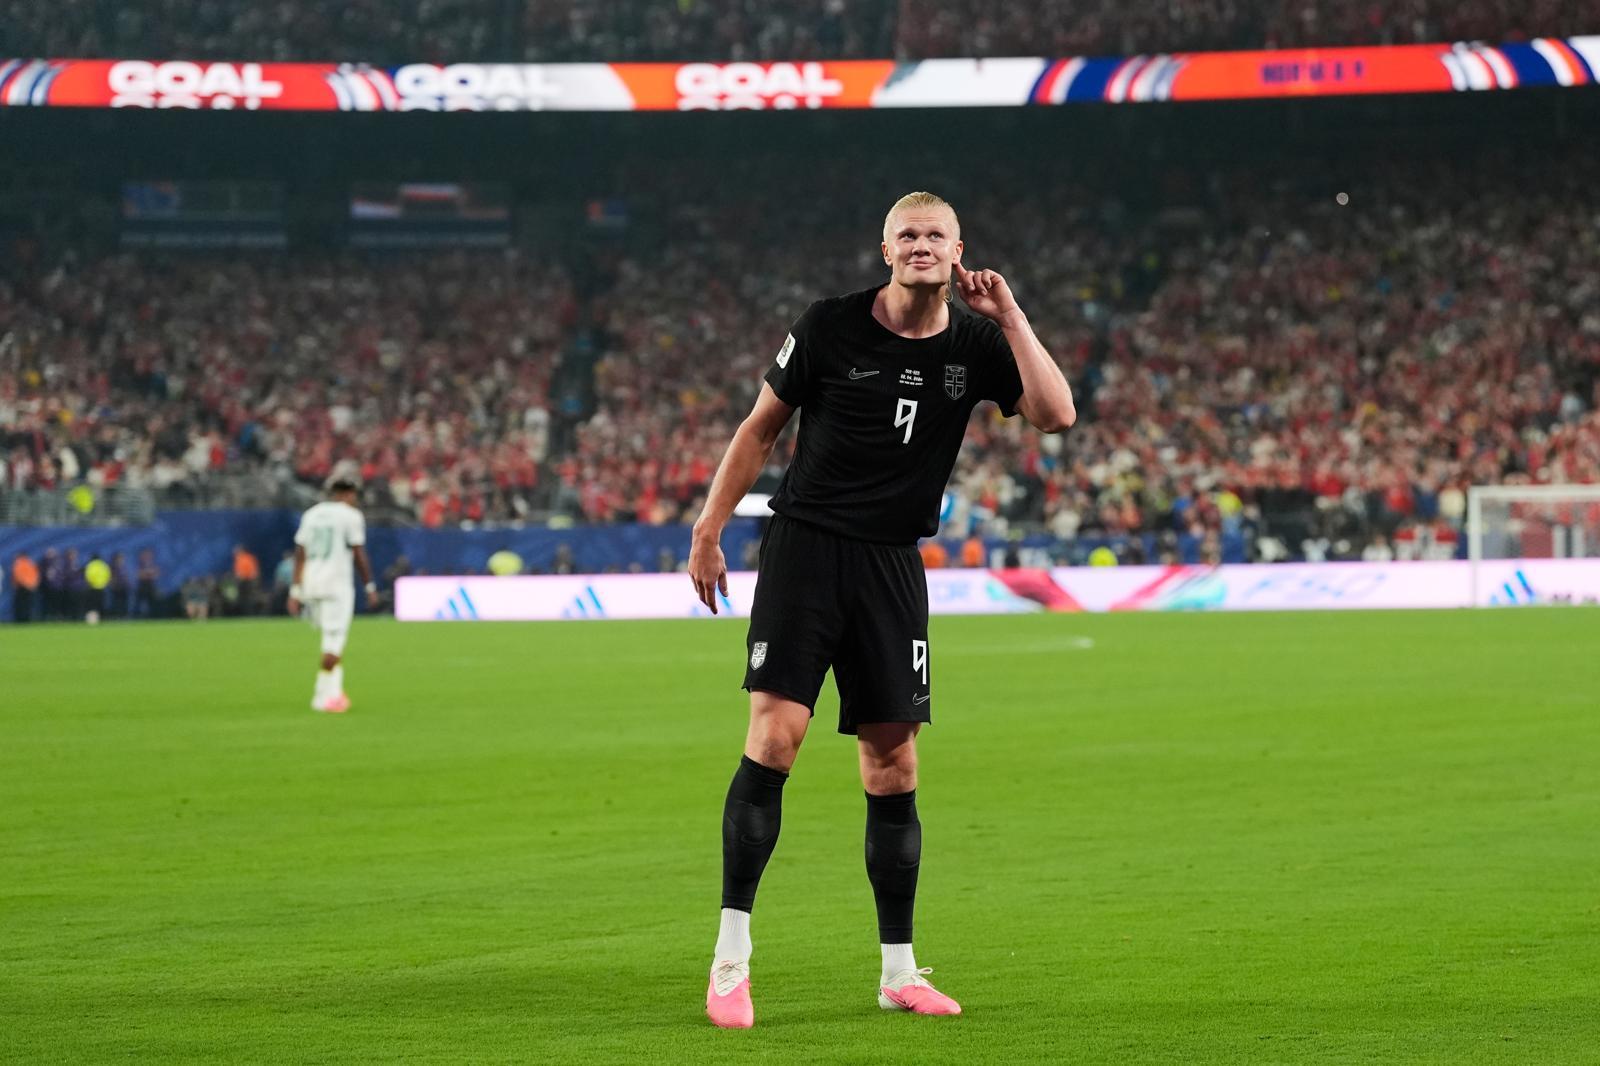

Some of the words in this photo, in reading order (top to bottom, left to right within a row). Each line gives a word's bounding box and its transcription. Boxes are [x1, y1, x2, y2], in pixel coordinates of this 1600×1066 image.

[107, 61, 283, 98] GOAL
[396, 64, 563, 97] GOAL
[675, 62, 843, 97] GOAL
[894, 398, 918, 444] 9
[912, 639, 927, 685] 9
